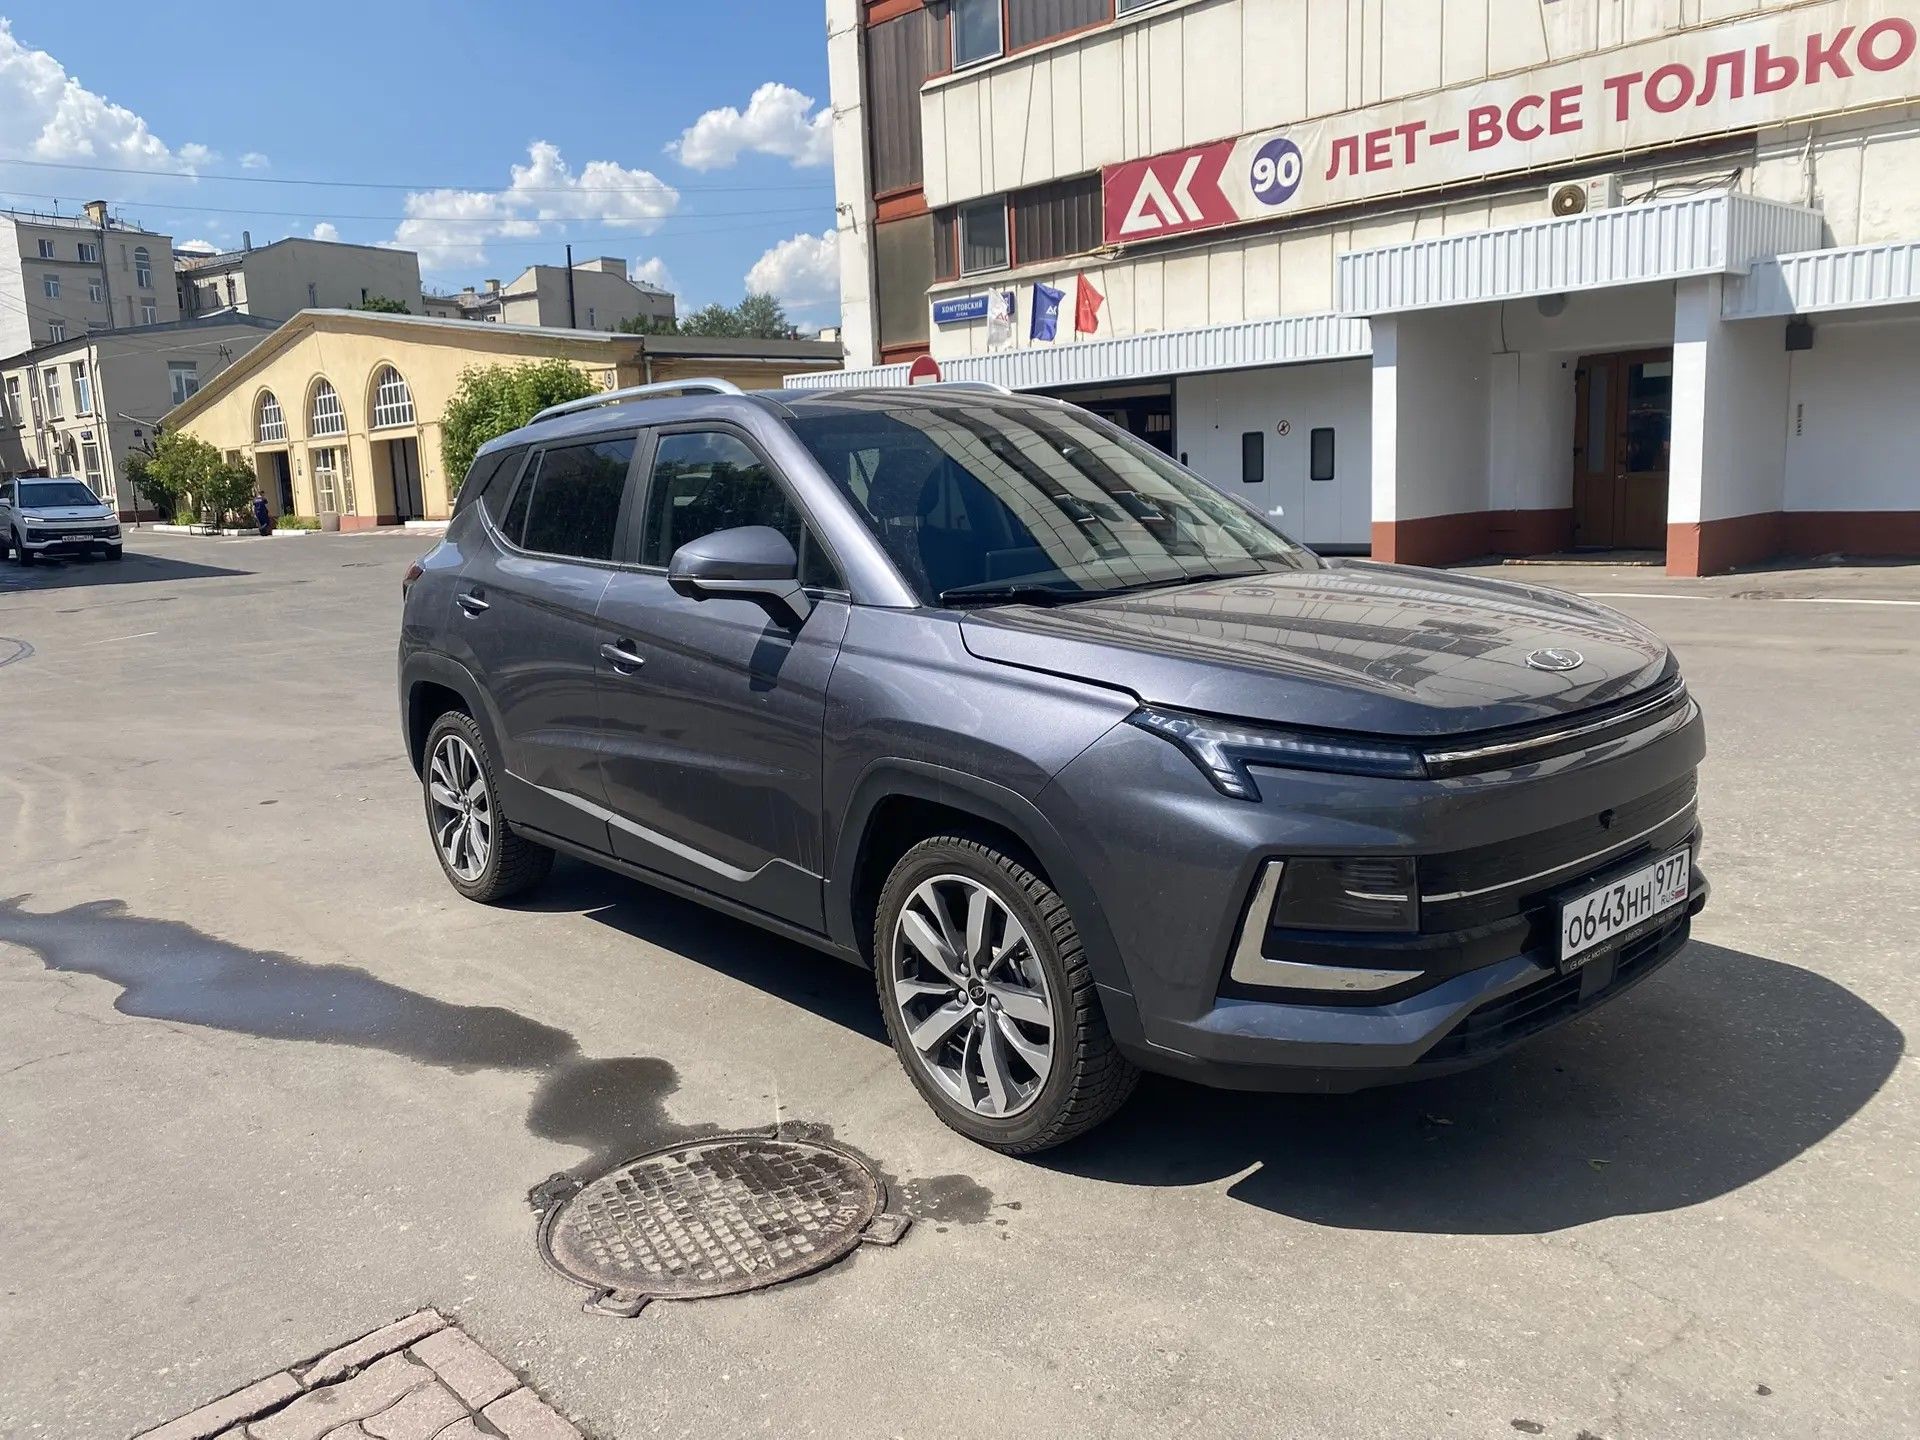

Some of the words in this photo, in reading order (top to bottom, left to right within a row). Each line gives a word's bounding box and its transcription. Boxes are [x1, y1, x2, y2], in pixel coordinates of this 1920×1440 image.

[1252, 152, 1300, 193] 90
[1604, 17, 1918, 122] ТОЛЬКО
[941, 300, 983, 313] ХОМУТОВСКИЙ
[1656, 854, 1684, 895] 977
[1661, 892, 1675, 906] RUS
